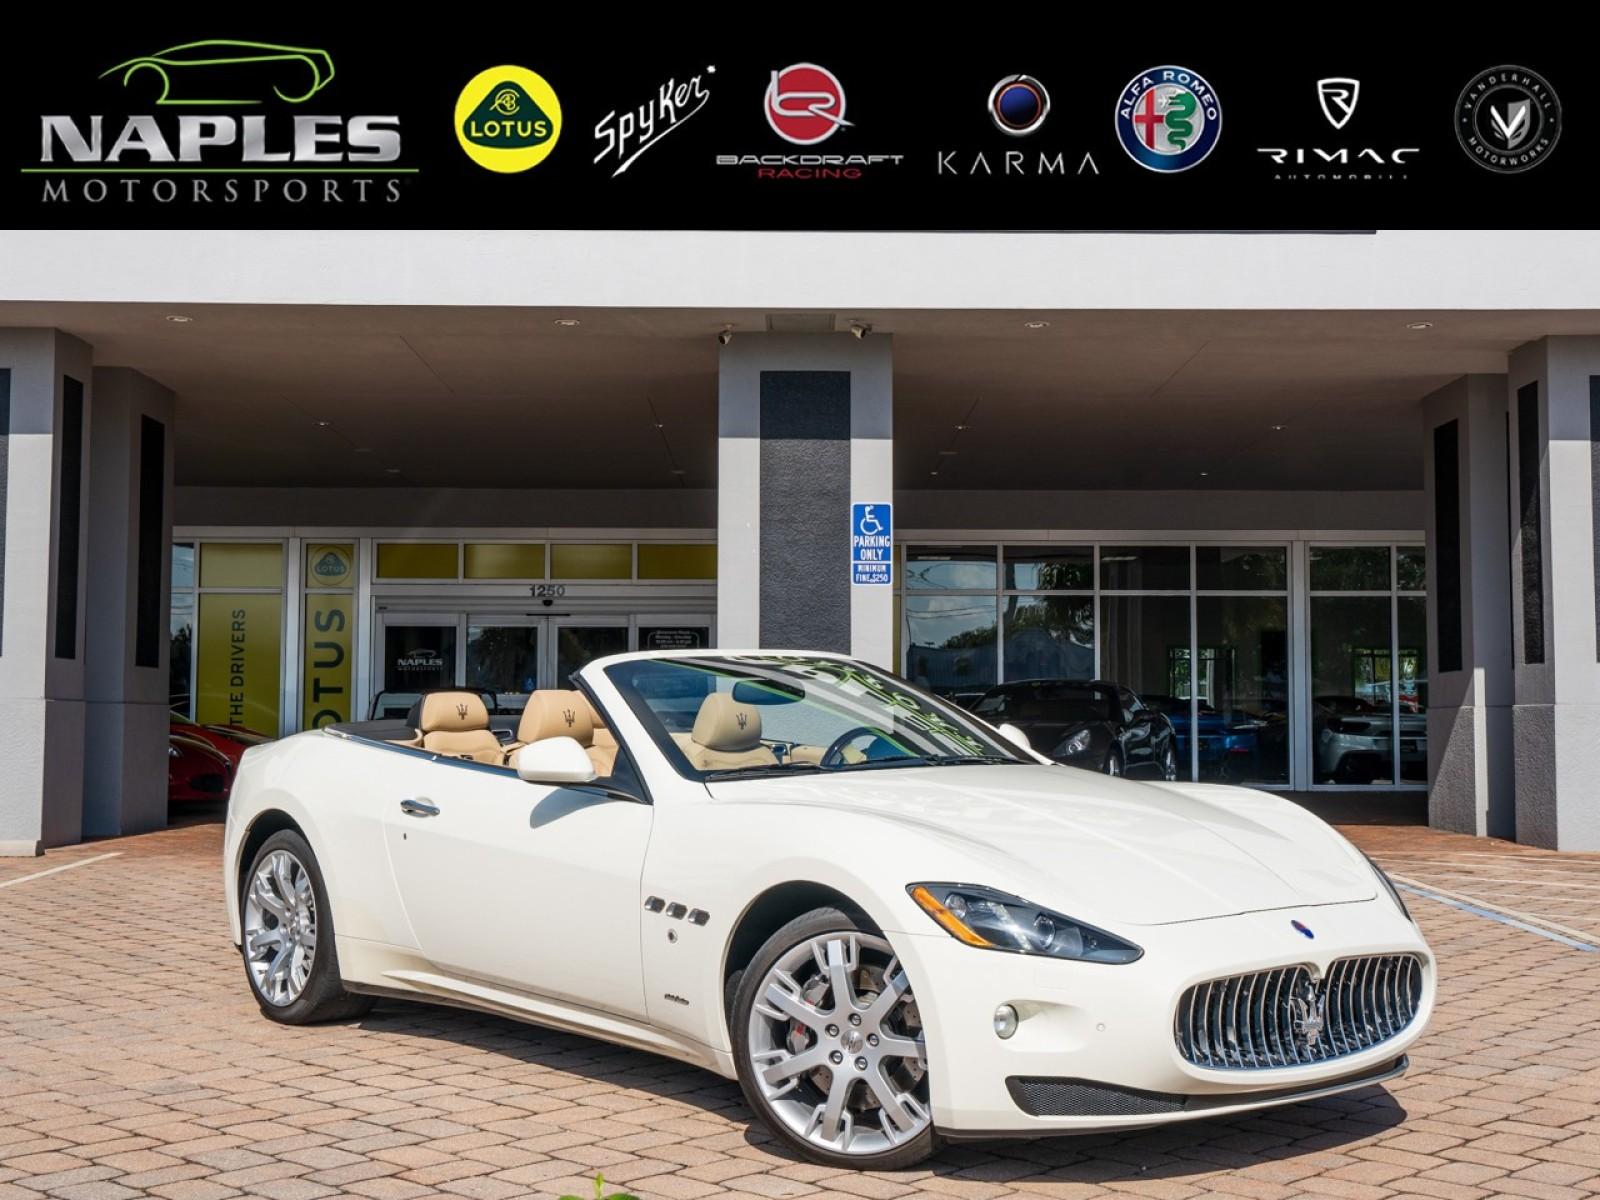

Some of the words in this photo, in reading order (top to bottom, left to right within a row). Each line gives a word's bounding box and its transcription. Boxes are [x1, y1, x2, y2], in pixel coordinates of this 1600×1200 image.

[854, 535, 890, 548] PARKING
[861, 548, 884, 561] ONLY
[858, 564, 887, 574] MINIMUM
[529, 583, 566, 597] 1250
[230, 608, 246, 687] DRIVERS
[312, 608, 346, 729] OTUS
[397, 658, 443, 666] NAPLES
[229, 692, 244, 727] THE
